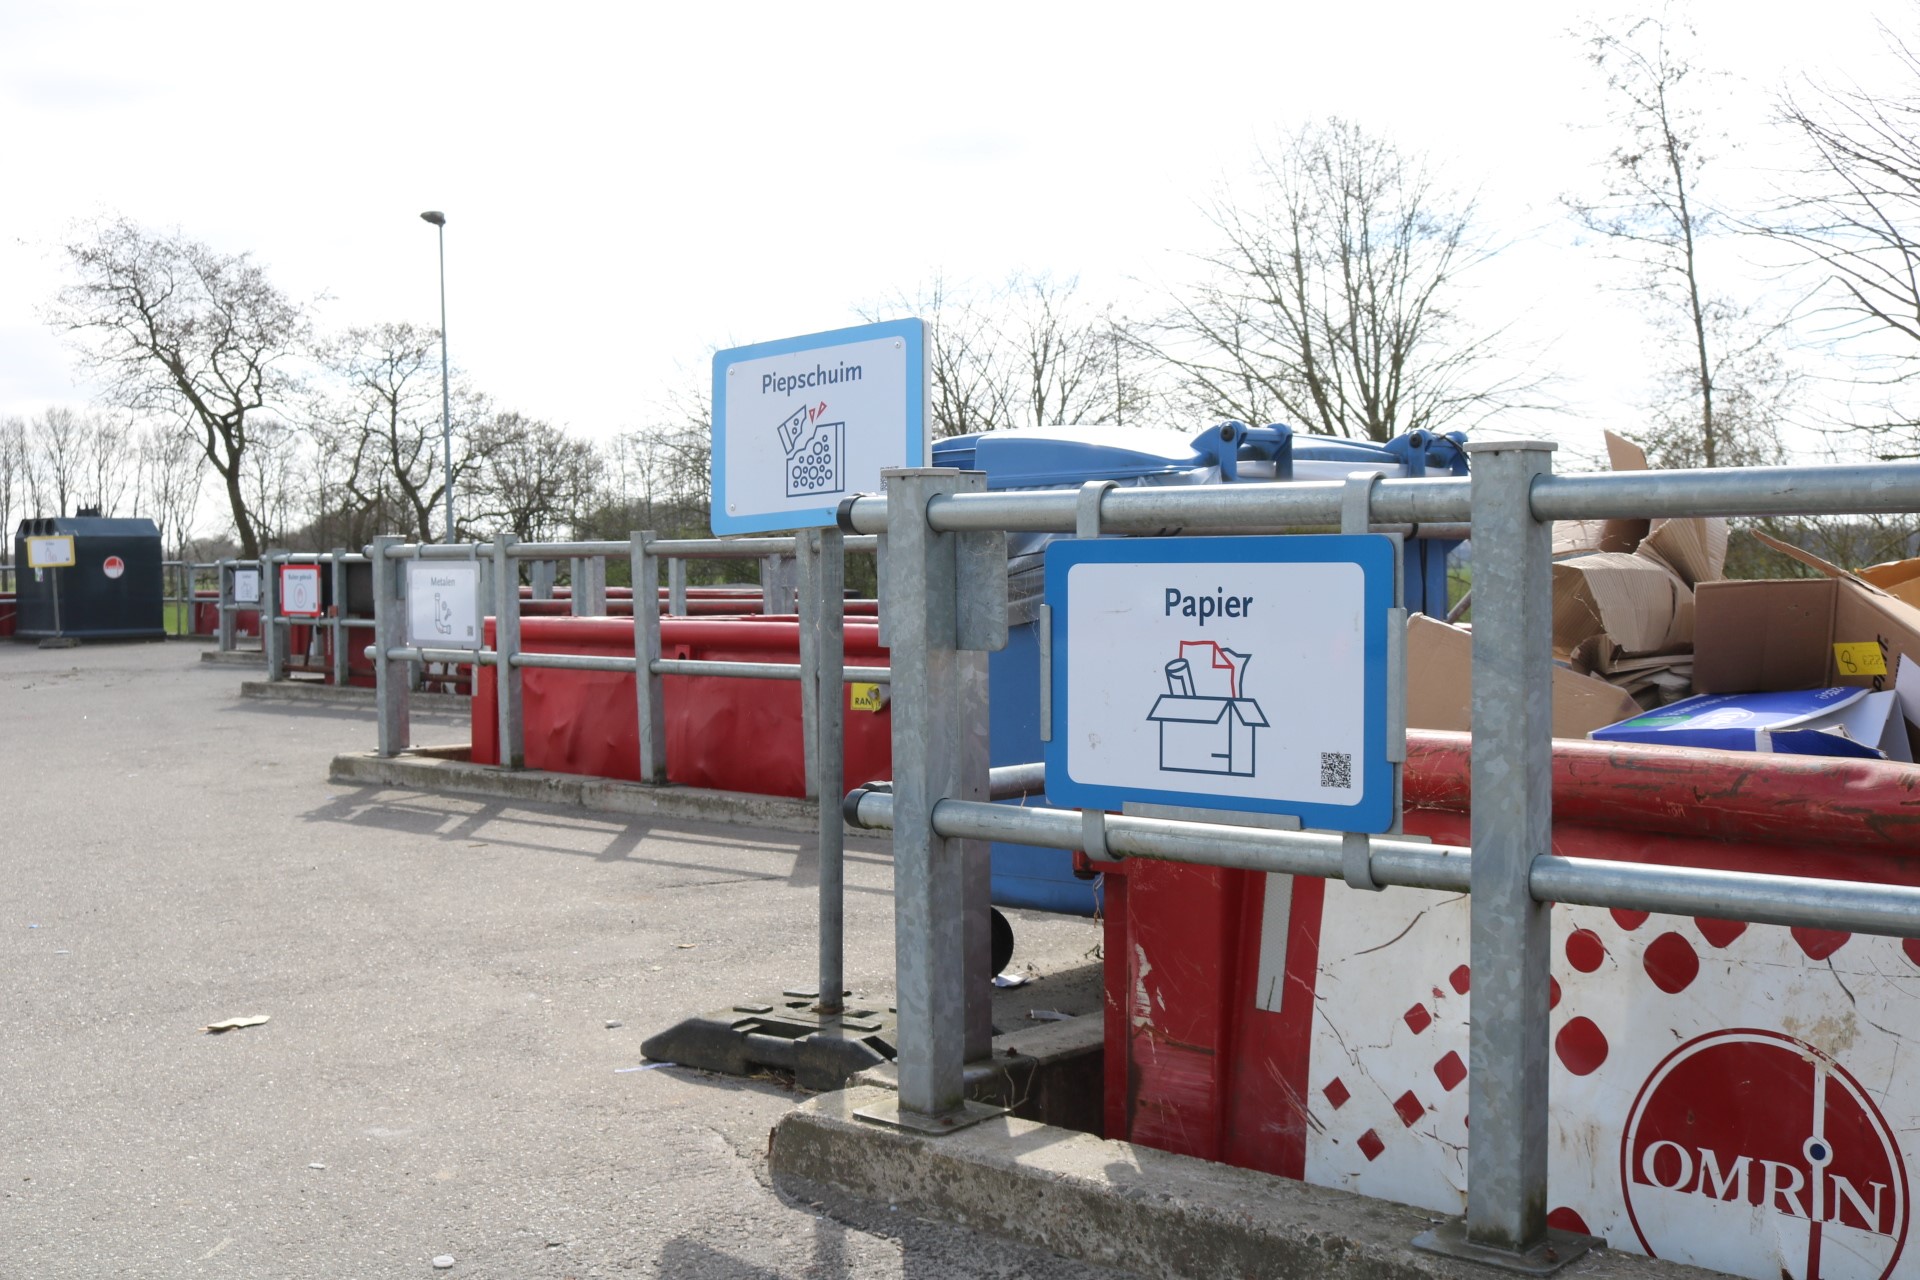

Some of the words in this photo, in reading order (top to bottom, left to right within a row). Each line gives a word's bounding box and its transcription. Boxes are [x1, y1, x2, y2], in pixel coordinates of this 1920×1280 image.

[762, 361, 862, 396] Piepschuim
[430, 576, 456, 587] Metalen
[1165, 586, 1253, 626] Papier
[1642, 1139, 1887, 1233] OMRIN
